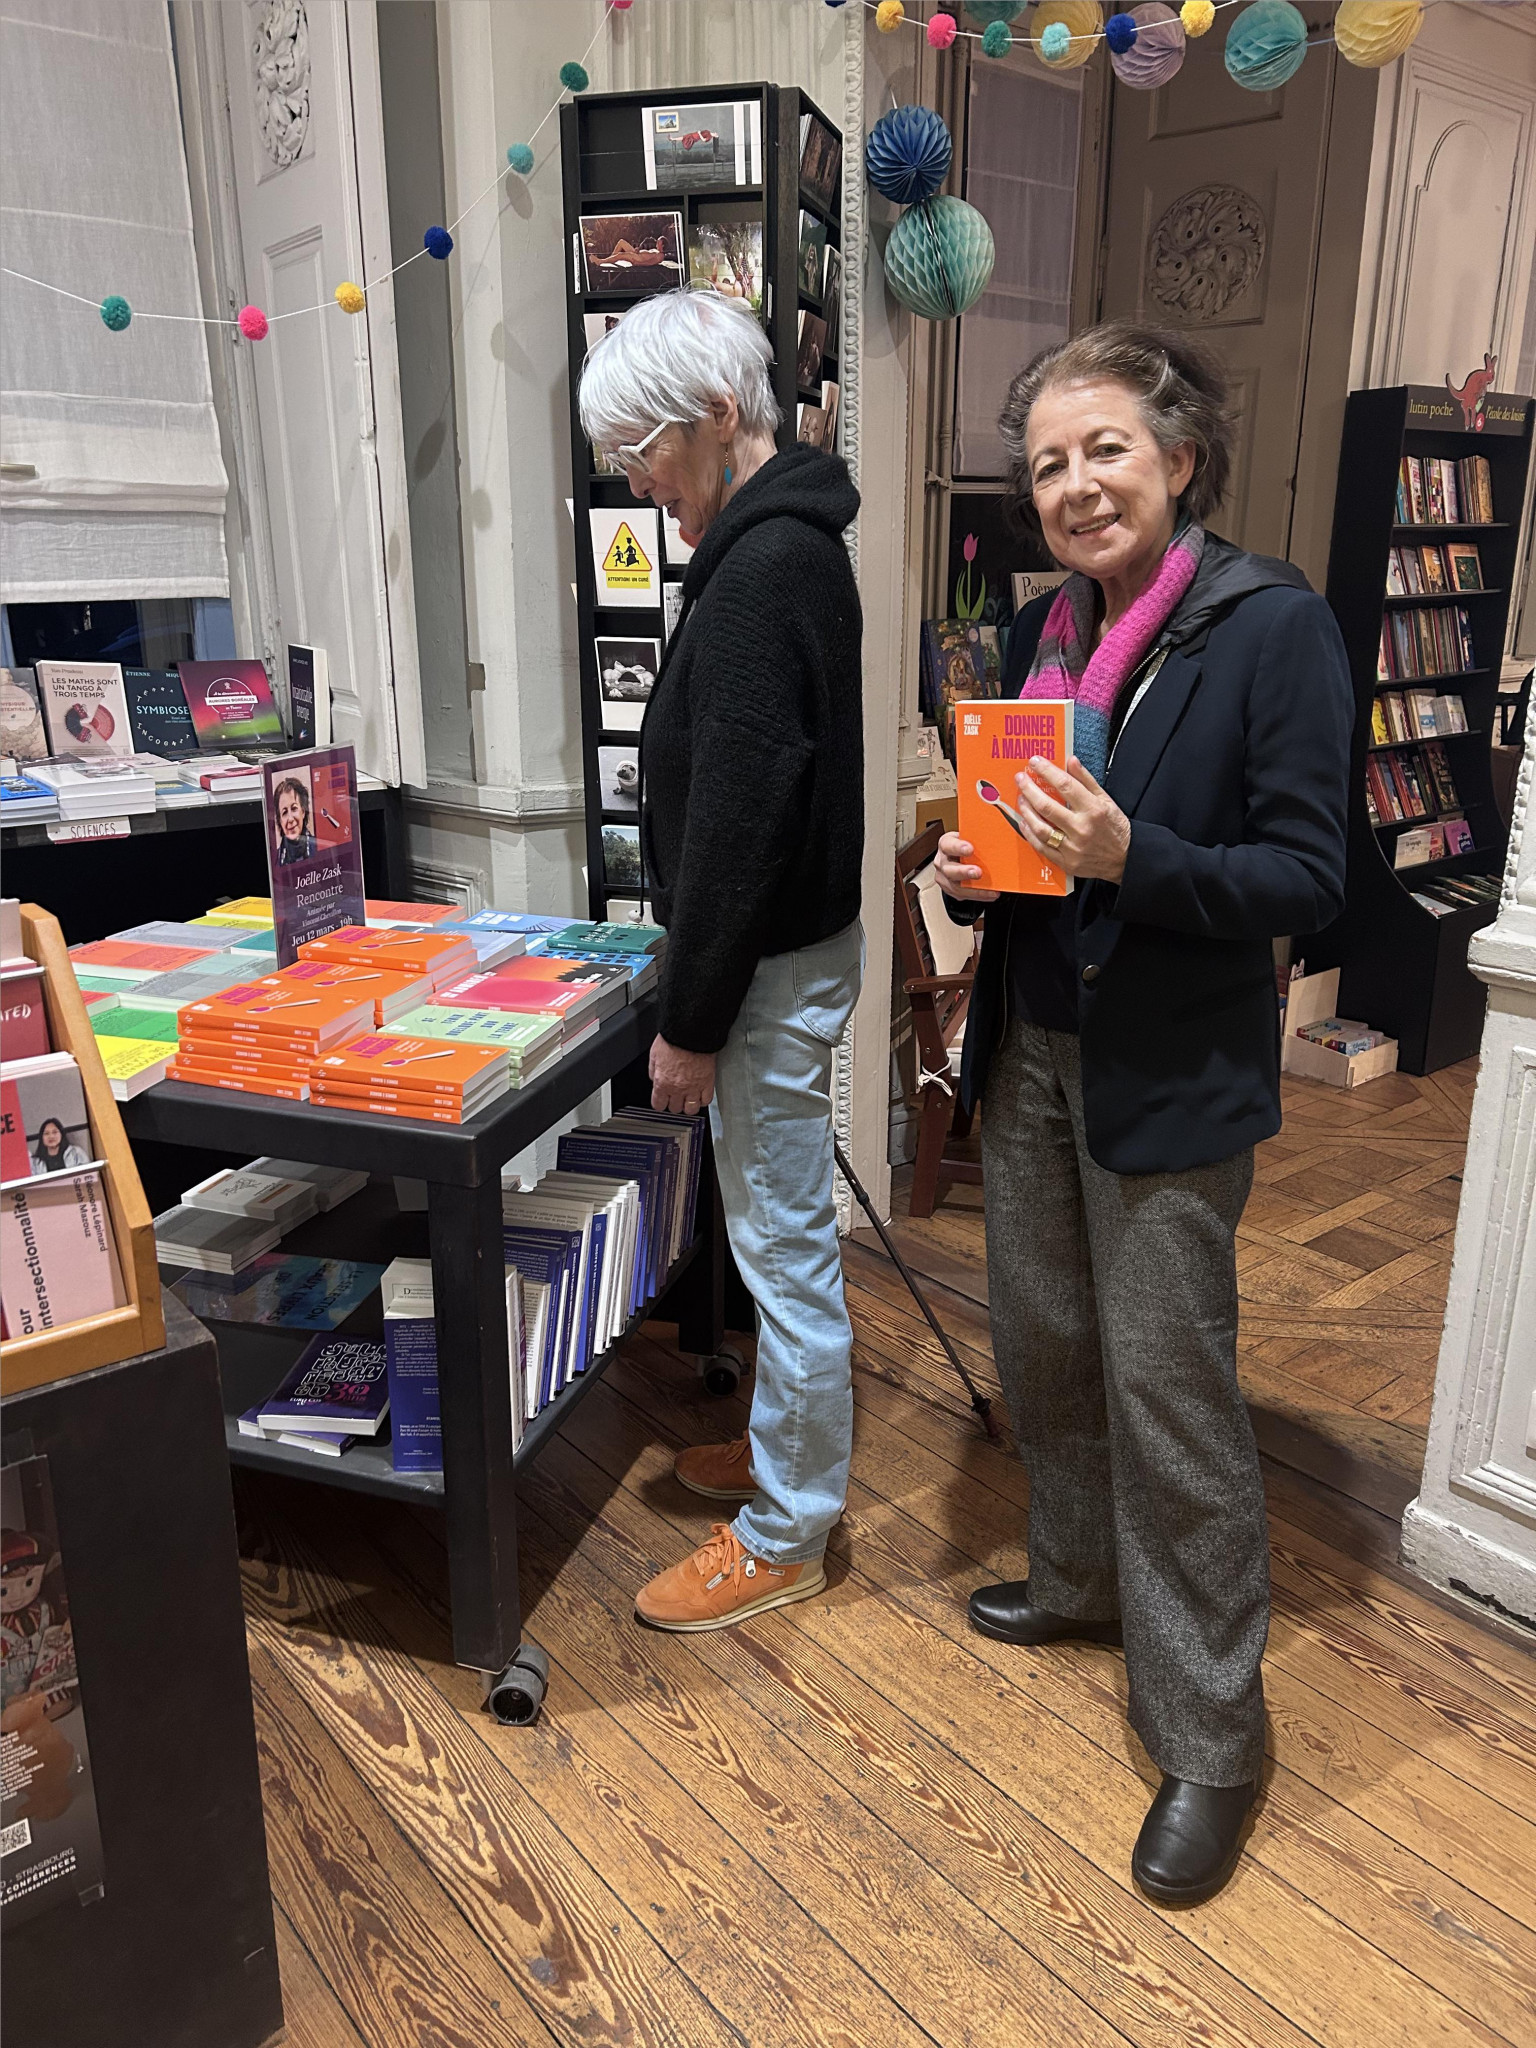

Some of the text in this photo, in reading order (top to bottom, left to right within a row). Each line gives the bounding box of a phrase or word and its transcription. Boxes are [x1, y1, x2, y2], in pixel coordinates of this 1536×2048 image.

[1409, 400, 1453, 419] lutin poche
[1502, 407, 1510, 421] des
[136, 706, 189, 715] SYMBIOSE
[964, 713, 981, 725] JOËLLE
[136, 722, 190, 746] INCOGNIT
[964, 725, 979, 736] ZASK
[1004, 714, 1055, 737] DONNER
[991, 735, 1055, 760] À MANGER
[70, 822, 116, 838] SCIENCES
[295, 863, 342, 890] Joëlle Zask
[296, 883, 344, 908] Rencontre
[327, 901, 336, 911] par
[291, 935, 306, 947] Jeu
[306, 930, 315, 941] 12
[316, 923, 335, 935] mars
[340, 915, 353, 928] 19h
[0, 1003, 31, 1021] TED
[72, 1177, 92, 1238] Sarah Mazouz
[92, 1212, 108, 1253] Lépinard
[19, 1308, 34, 1335] our
[6, 1856, 76, 1894] CONFÉRENCES
[15, 1847, 74, 1880] STRASBOURG
